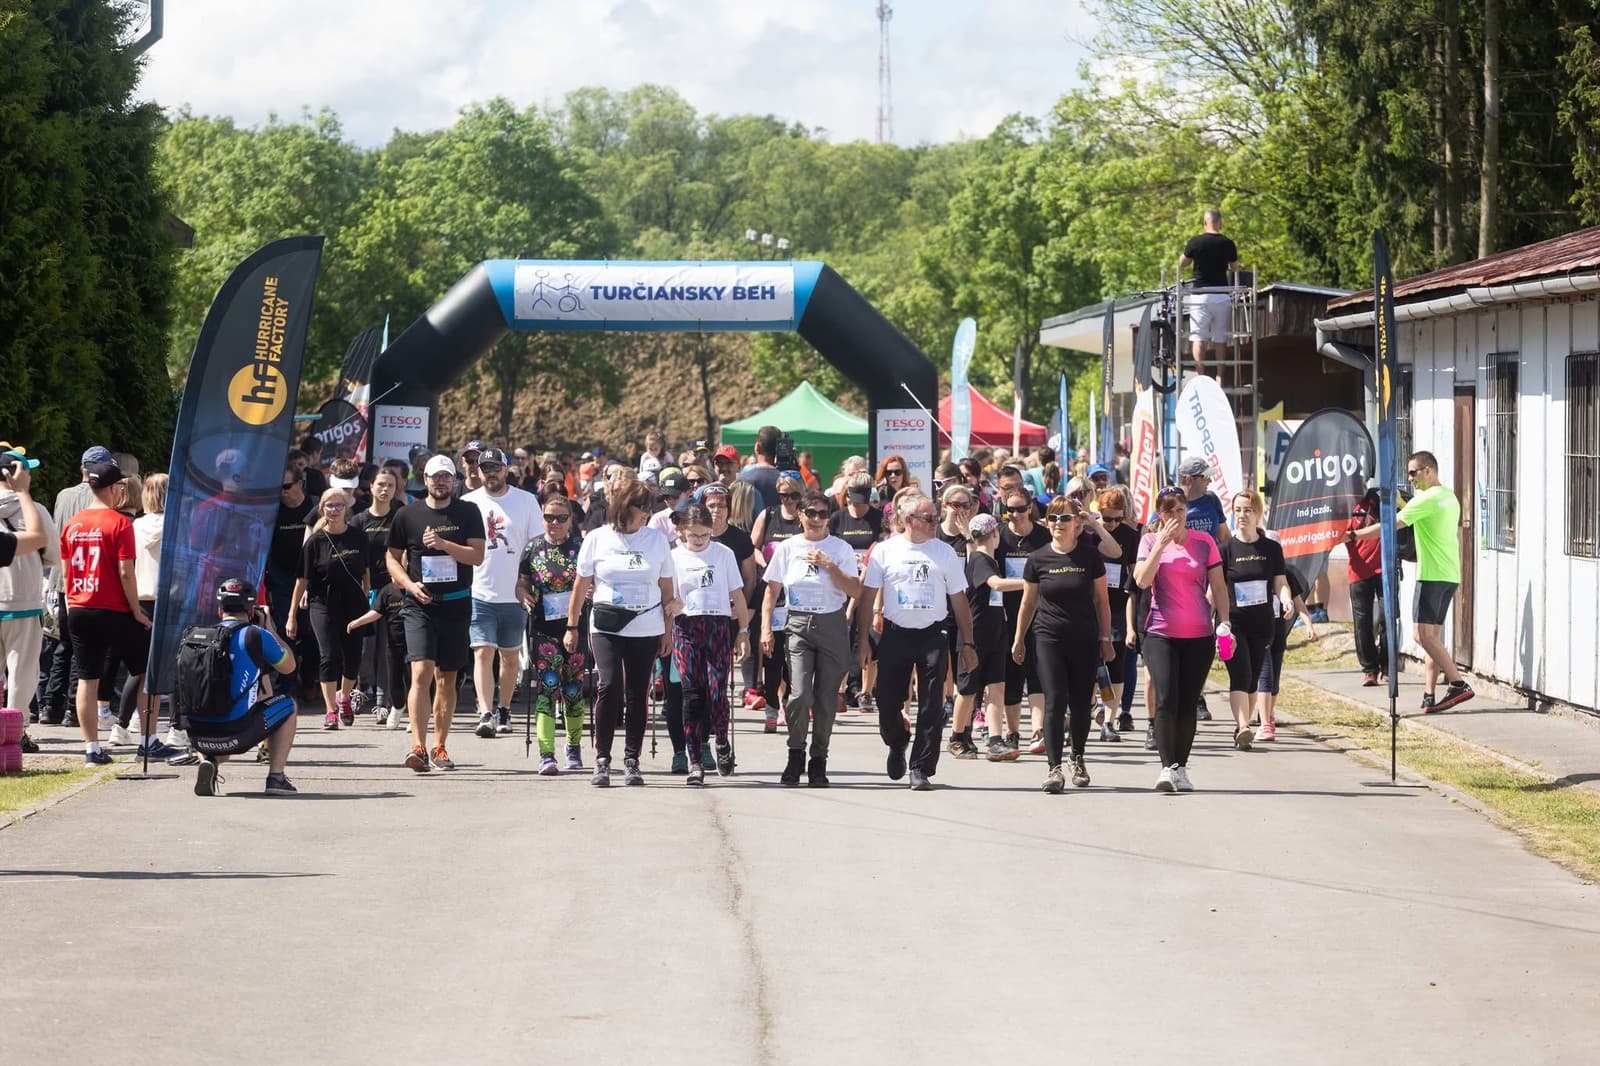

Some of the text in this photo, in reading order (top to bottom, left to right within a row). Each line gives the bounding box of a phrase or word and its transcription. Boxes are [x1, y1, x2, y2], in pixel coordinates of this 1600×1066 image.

[590, 282, 776, 300] TURČIANSKY BEH
[254, 276, 279, 360] HURRICANE
[268, 297, 289, 362] FACTORY
[382, 415, 422, 426] TESCO
[884, 418, 925, 428] TESCO
[71, 546, 101, 571] 47
